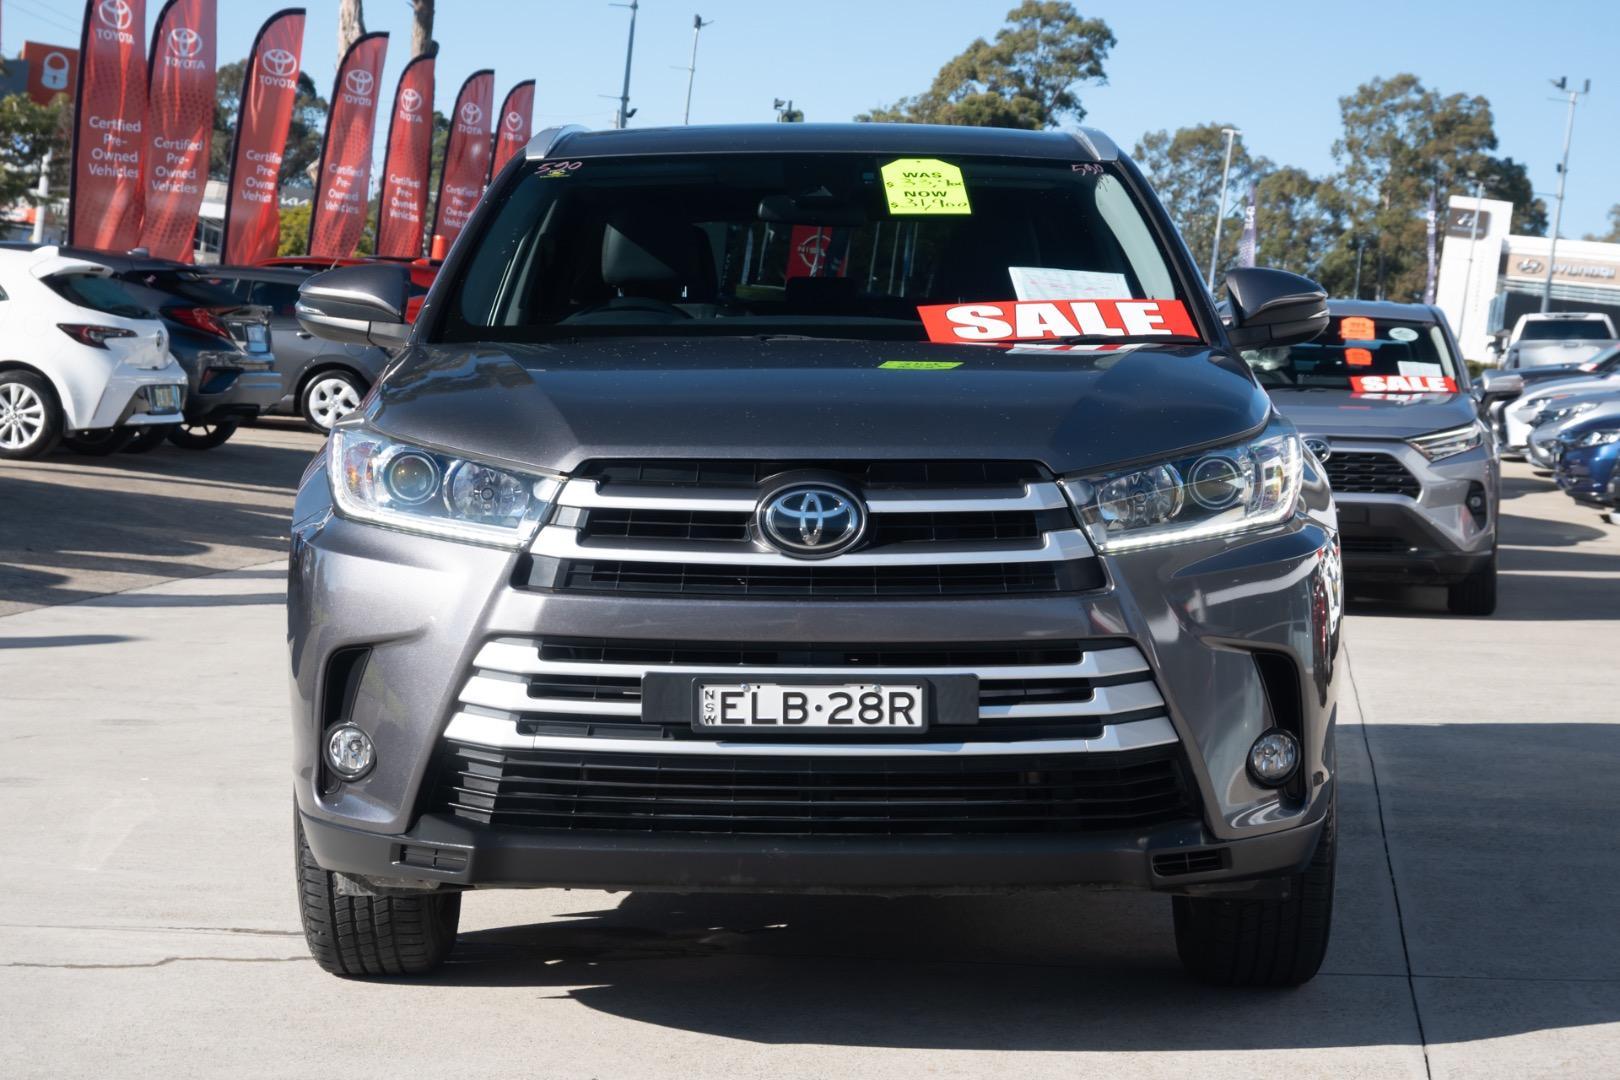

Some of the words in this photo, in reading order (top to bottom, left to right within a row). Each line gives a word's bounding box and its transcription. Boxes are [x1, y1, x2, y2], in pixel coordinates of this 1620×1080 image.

[95, 28, 134, 45] TOYOTA
[163, 56, 205, 70] TOYOTA
[260, 74, 296, 90] TOYOTA
[342, 93, 372, 107] TOYO
[399, 110, 423, 123] TOTA
[89, 115, 142, 133] Certified
[458, 123, 483, 135] TYOTA
[103, 133, 128, 147] Pre-
[153, 136, 204, 151] Certified
[91, 148, 138, 163] Owned
[166, 152, 190, 164] Pre-
[246, 149, 282, 164] Certifie
[88, 163, 139, 178] Vehicles
[155, 167, 197, 180] Owned
[151, 180, 198, 194] Vehicles
[903, 190, 947, 198] NOW
[945, 301, 1173, 340] SALE
[1360, 376, 1449, 392] SALE
